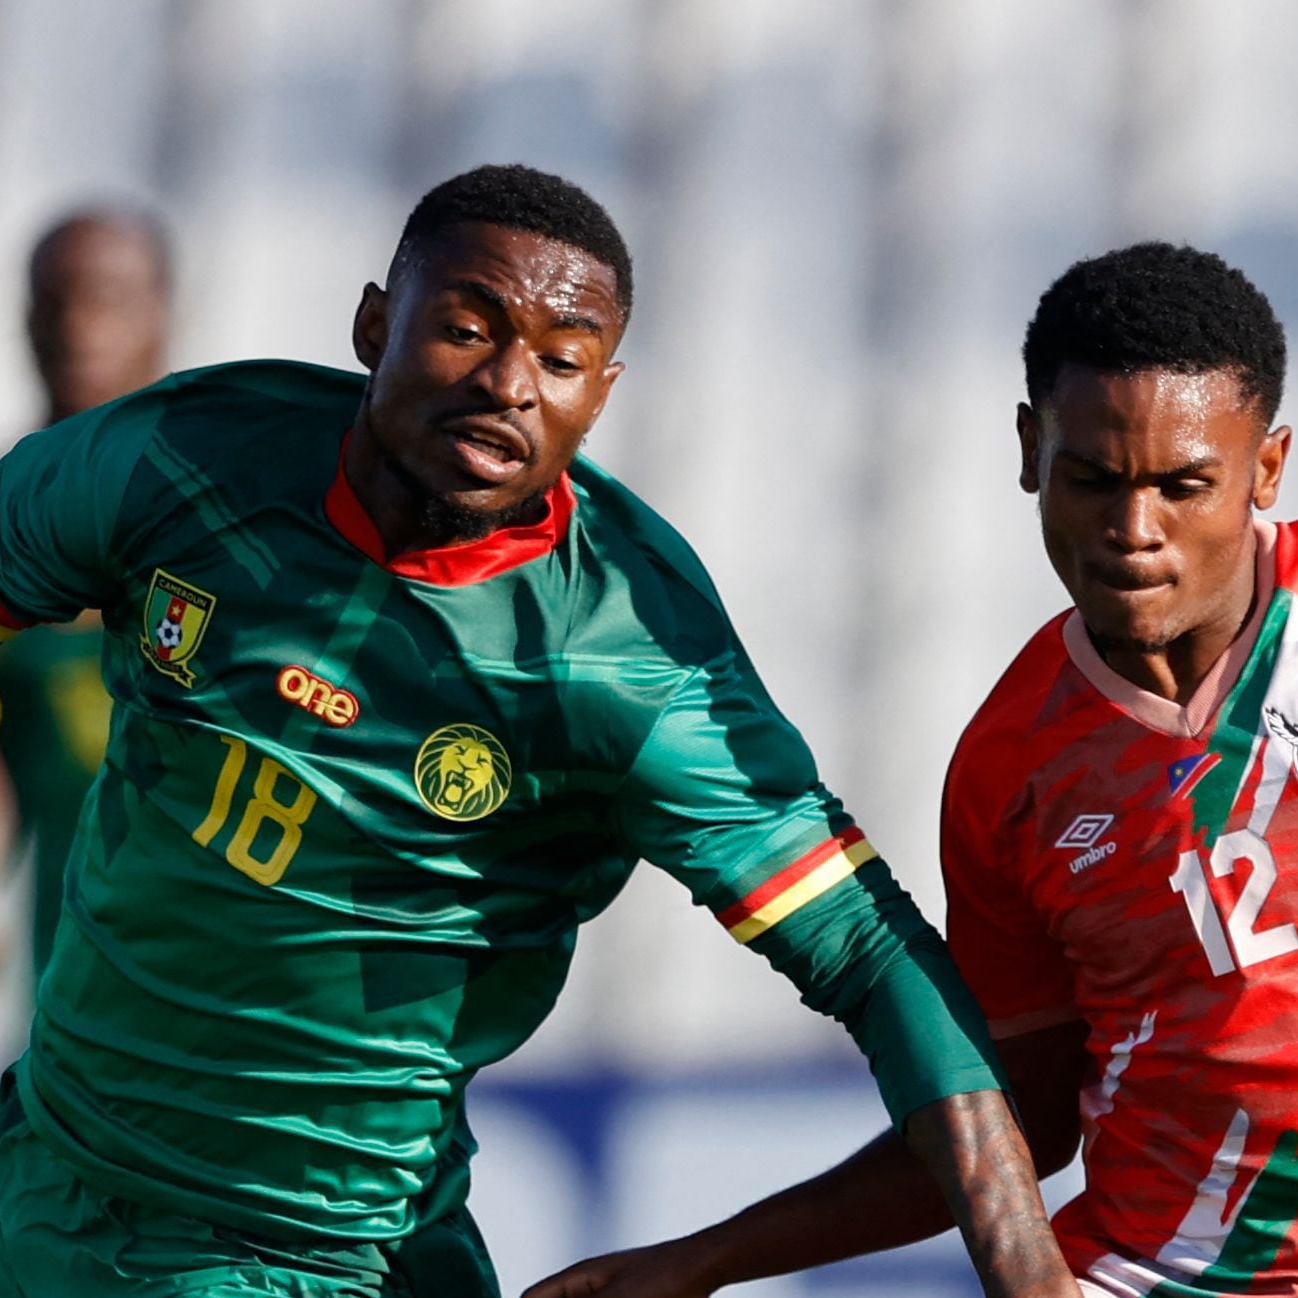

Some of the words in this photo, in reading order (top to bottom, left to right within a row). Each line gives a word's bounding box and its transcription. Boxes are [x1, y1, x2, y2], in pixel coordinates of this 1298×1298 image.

[158, 578, 208, 608] CAMEROUN
[276, 664, 359, 728] one
[192, 735, 317, 887] 18
[1069, 841, 1117, 874] umbro
